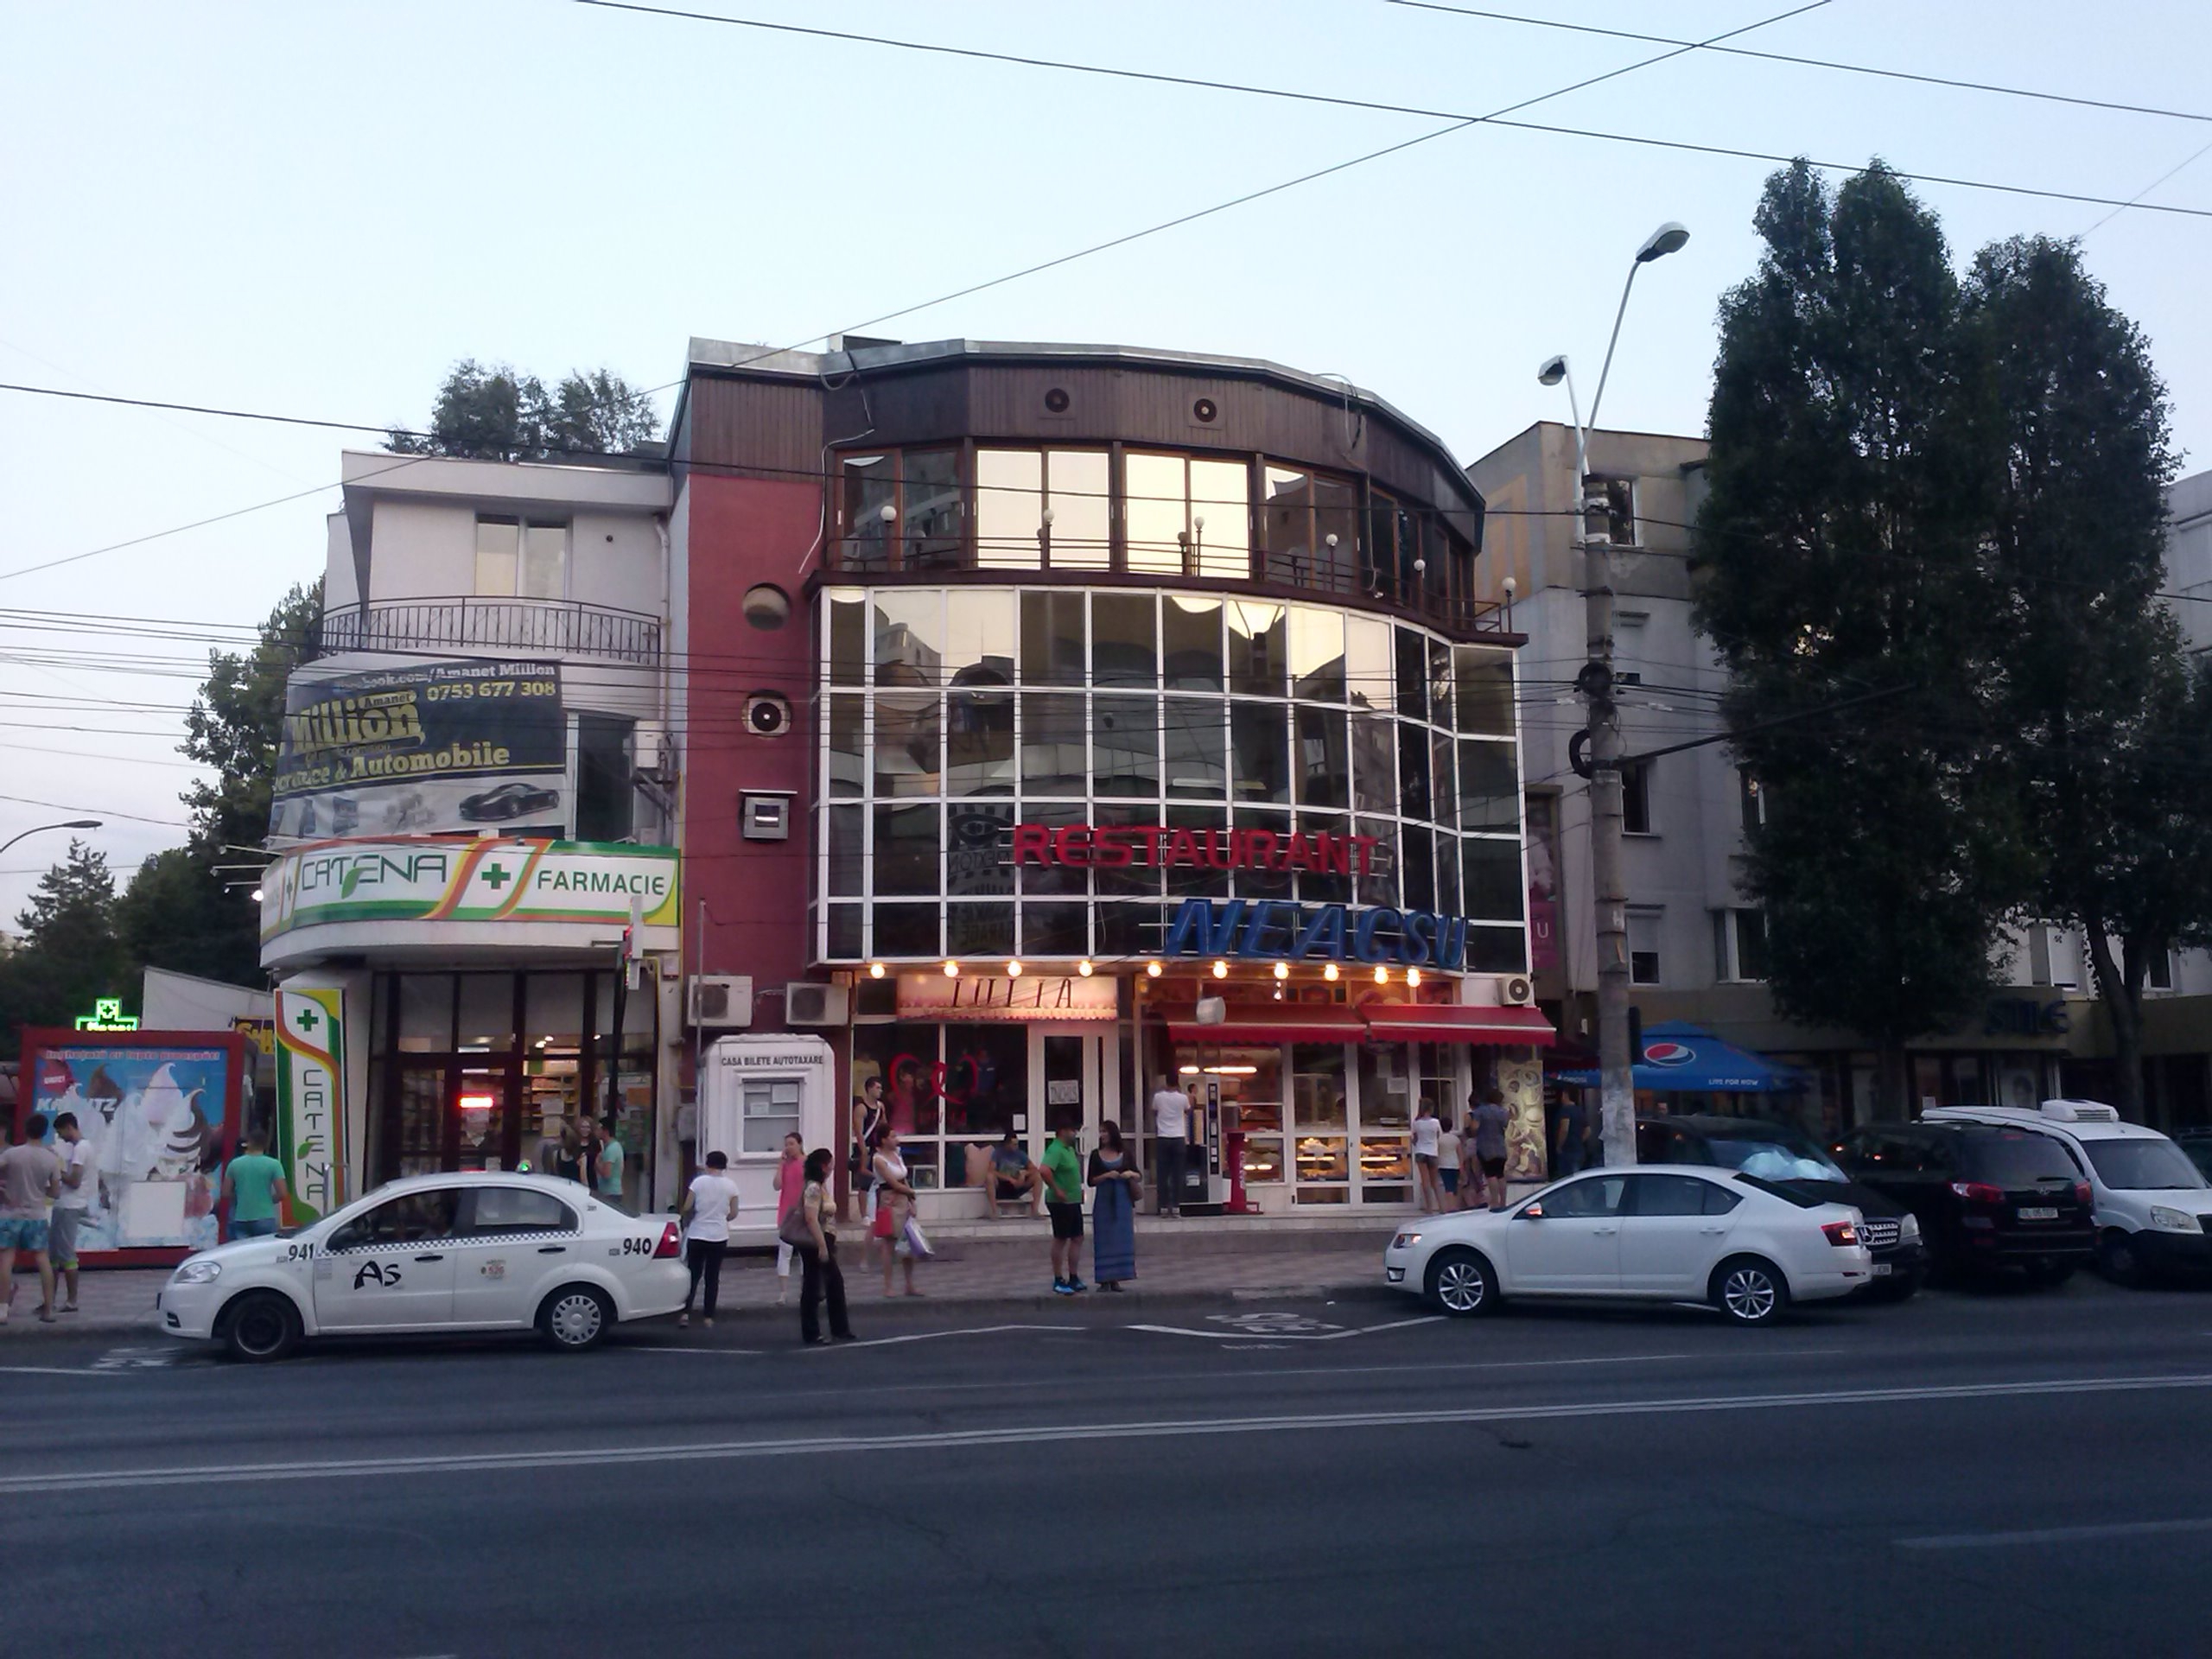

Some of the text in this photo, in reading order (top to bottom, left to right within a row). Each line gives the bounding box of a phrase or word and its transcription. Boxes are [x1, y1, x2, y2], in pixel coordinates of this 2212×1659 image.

[499, 663, 556, 676] Million
[364, 692, 411, 708] Amanet
[427, 681, 556, 701] 0753 677 308
[289, 699, 423, 755] Million
[350, 741, 511, 778] Automobile
[1014, 823, 1380, 877] RESTAURANT
[302, 854, 447, 895] CATENA
[537, 869, 665, 896] FARMACIE
[721, 1055, 823, 1066] CASA BILETE AUTOTAXARE
[302, 1069, 325, 1201] CATENA
[288, 1243, 315, 1262] 941
[623, 1237, 652, 1255] 940
